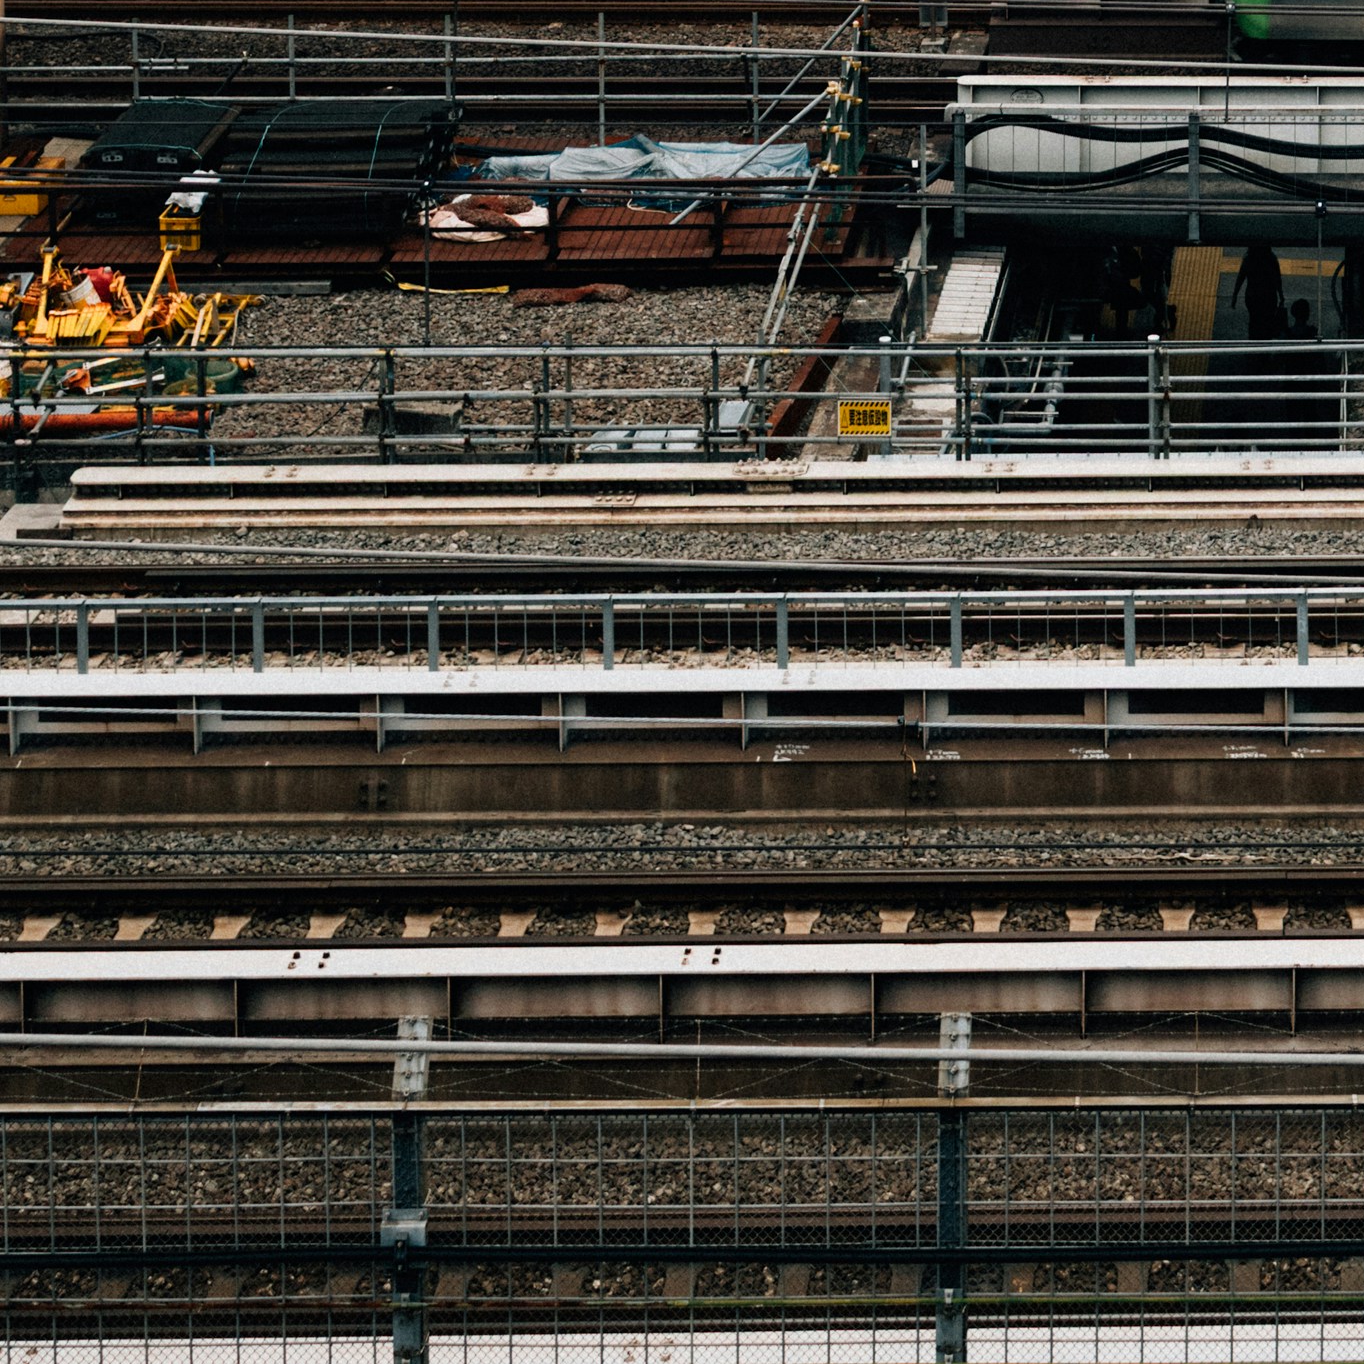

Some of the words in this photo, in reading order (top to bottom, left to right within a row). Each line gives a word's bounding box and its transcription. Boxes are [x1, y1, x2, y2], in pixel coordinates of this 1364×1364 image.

[848, 409, 888, 426] 要注意仮設物
